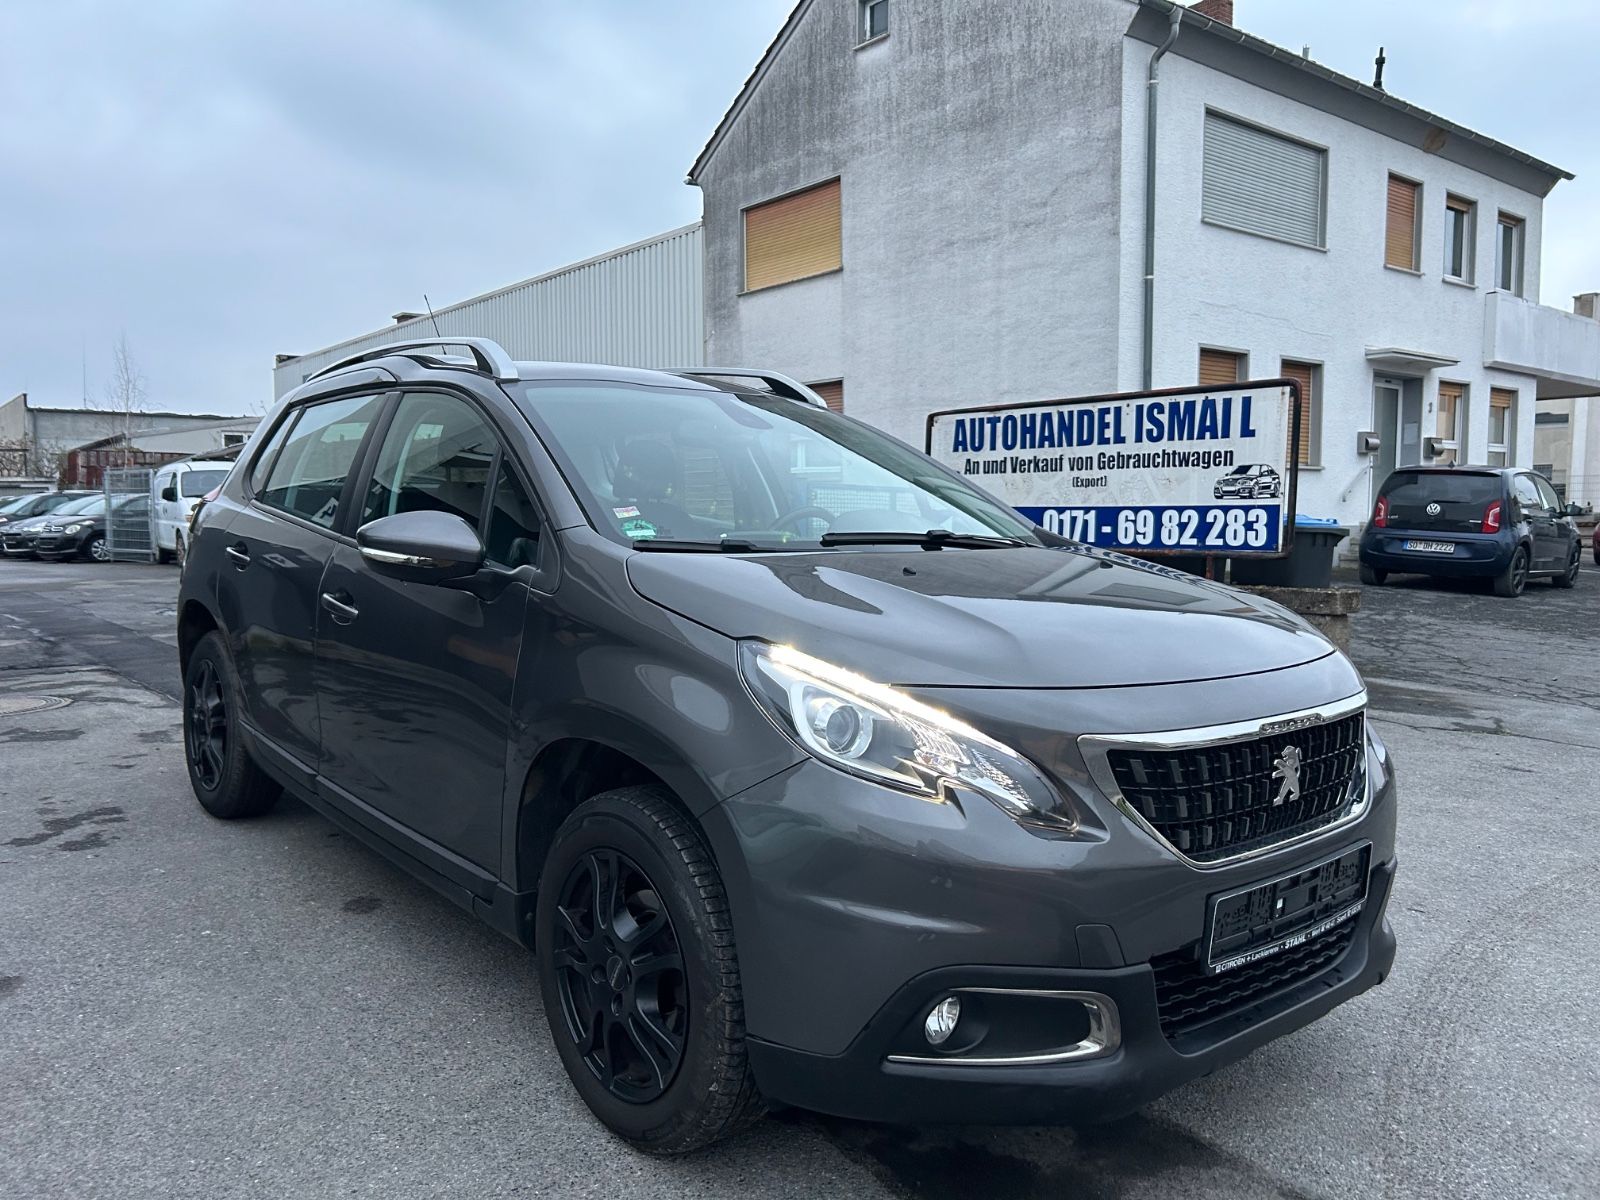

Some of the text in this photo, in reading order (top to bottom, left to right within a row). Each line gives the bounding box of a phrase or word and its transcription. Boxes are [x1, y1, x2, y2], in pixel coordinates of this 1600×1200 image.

[952, 406, 1126, 452] AUTOHANDEL
[964, 449, 1234, 475] An und Verkauf von Gebrauchtwagen
[1042, 509, 1096, 543] 0171
[1117, 509, 1154, 545] 69
[1160, 509, 1199, 546] 82
[1205, 508, 1268, 547] 283
